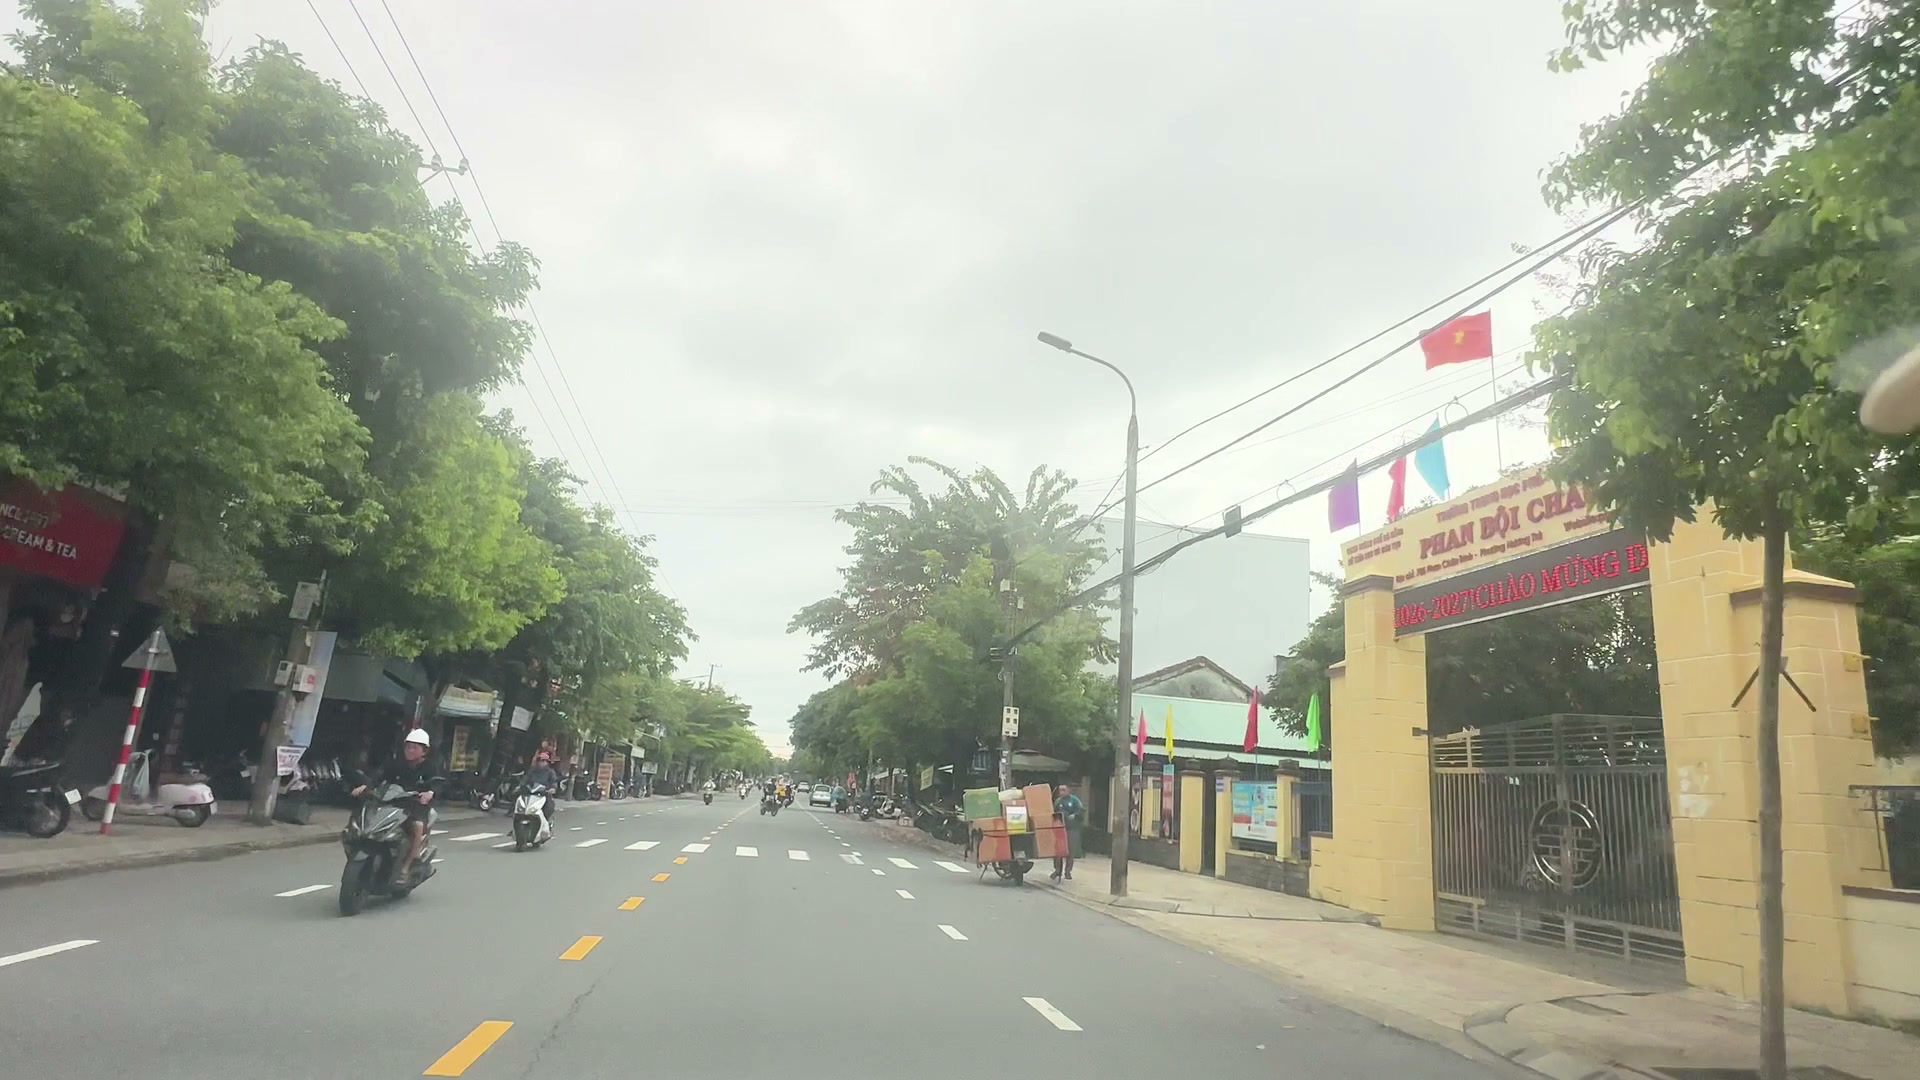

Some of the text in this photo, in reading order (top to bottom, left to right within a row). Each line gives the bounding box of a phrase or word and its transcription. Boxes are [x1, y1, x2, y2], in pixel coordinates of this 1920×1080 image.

[45, 538, 54, 552] &
[57, 542, 77, 559] TEA
[1420, 521, 1474, 560] PHAN
[1480, 505, 1520, 540] BỘI
[1541, 550, 1621, 594] MỪNG
